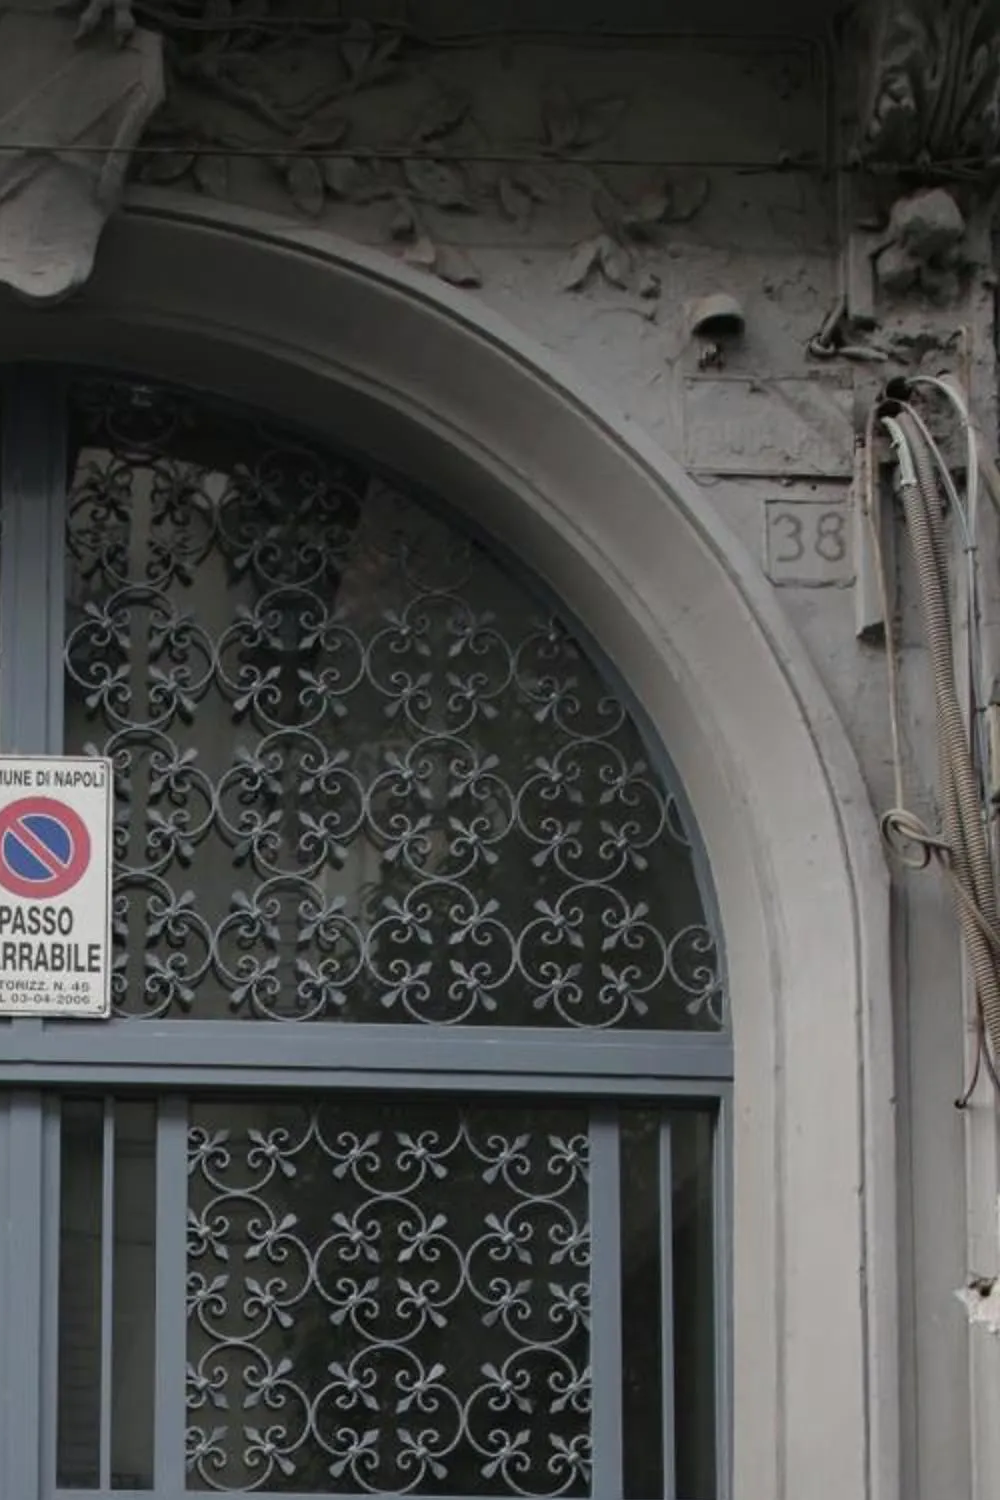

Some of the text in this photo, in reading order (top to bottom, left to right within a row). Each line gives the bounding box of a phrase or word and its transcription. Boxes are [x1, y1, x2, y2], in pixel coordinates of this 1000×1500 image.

[772, 511, 846, 562] 38
[36, 770, 50, 786] DI
[53, 770, 104, 787] NAPOLI
[53, 980, 67, 992] N.
